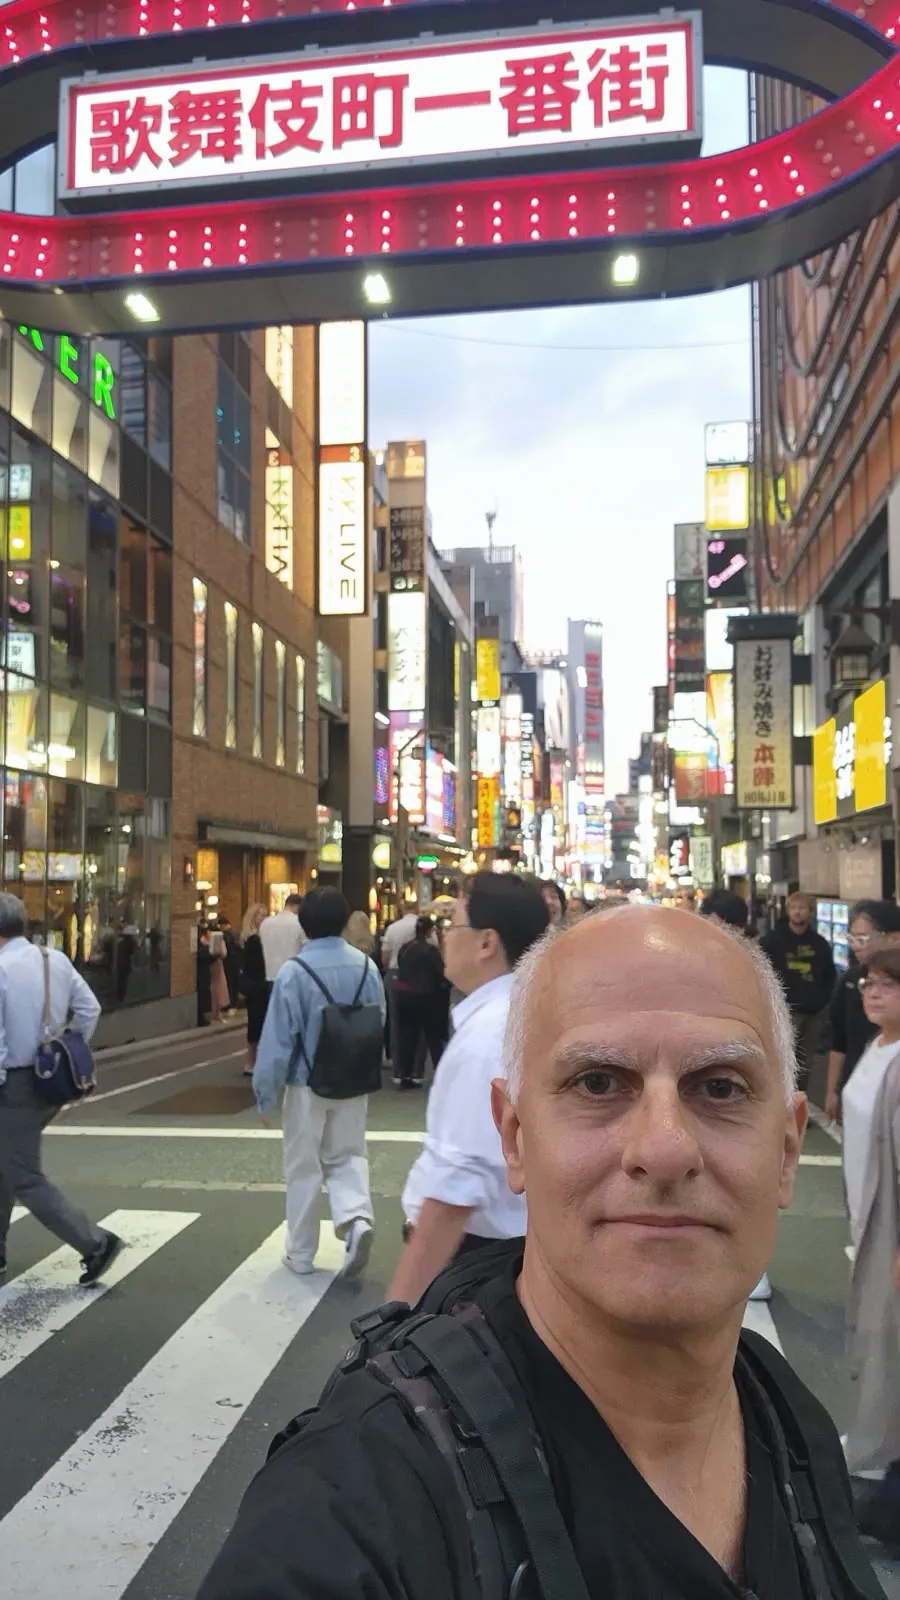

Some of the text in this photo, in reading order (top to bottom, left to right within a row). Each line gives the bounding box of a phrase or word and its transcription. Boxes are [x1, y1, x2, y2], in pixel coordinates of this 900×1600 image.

[89, 43, 669, 176] 歌舞伎町一番街
[18, 325, 116, 420] ER
[340, 522, 356, 599] LIVE
